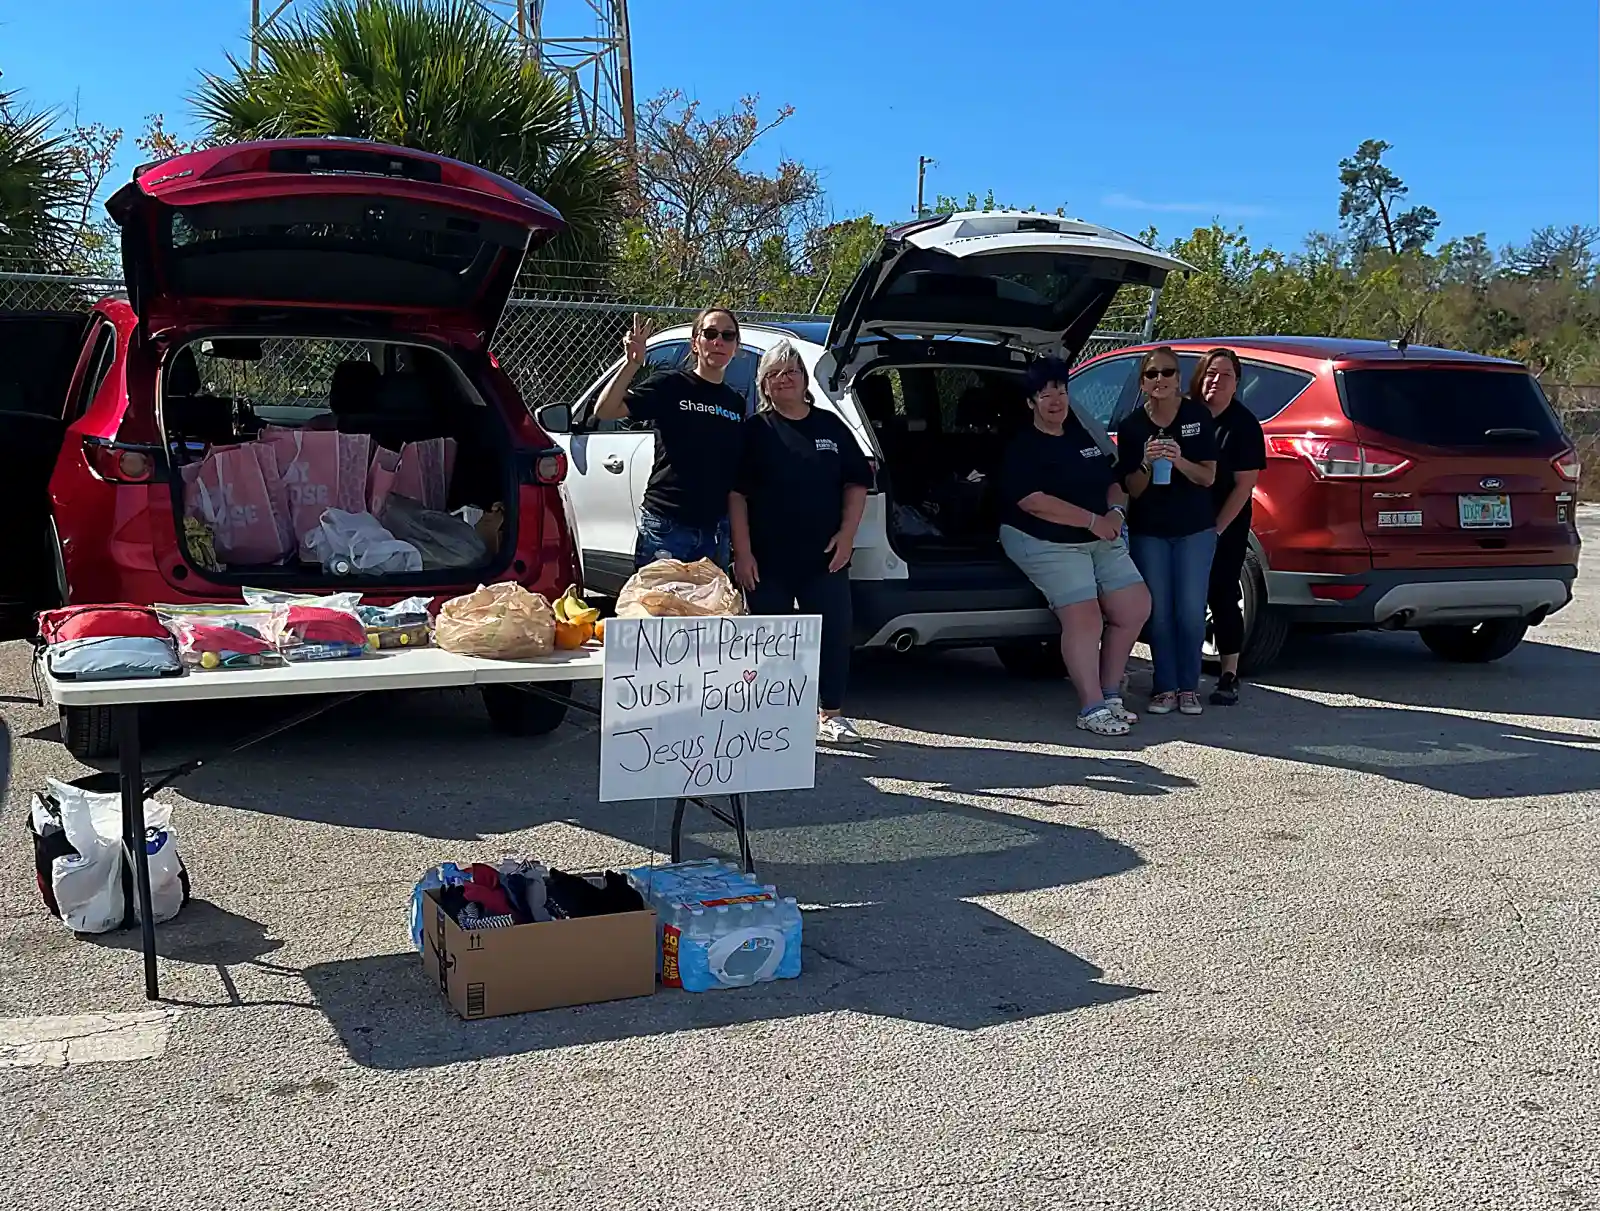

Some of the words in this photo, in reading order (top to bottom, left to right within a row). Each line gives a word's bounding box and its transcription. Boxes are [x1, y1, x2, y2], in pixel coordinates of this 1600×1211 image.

[718, 616, 802, 665] Perfect
[612, 673, 684, 711] Just
[612, 727, 705, 773] Jesus
[713, 719, 791, 760] Loves
